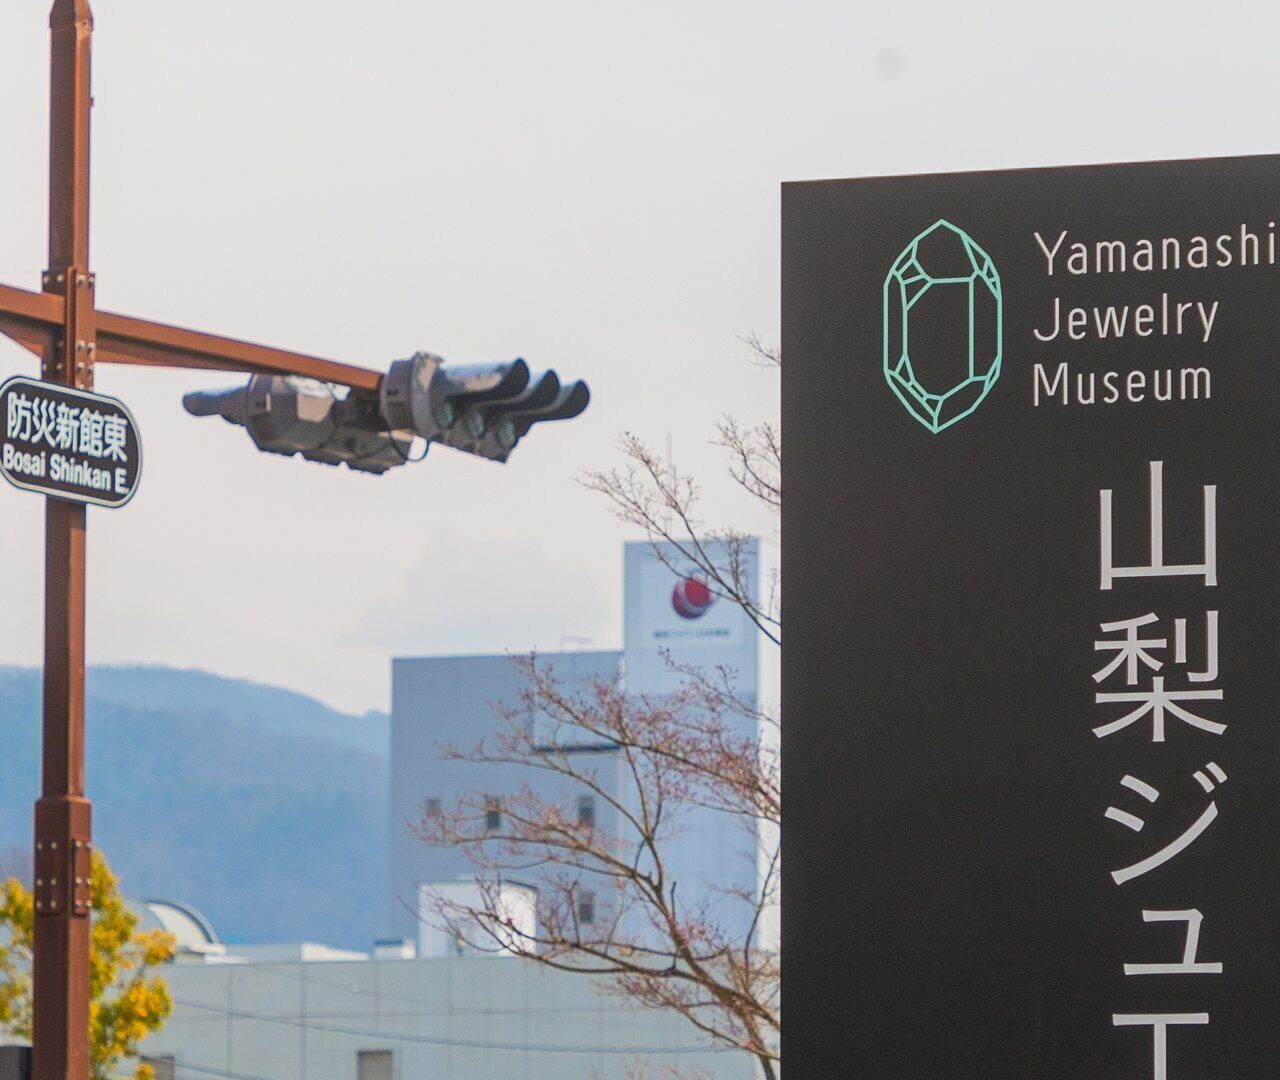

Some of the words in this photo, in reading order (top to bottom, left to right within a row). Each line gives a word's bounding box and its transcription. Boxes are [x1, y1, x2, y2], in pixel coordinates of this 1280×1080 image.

[1033, 221, 1277, 276] Yamanashi
[1033, 293, 1219, 343] Jewelry
[1033, 361, 1212, 407] Museum
[6, 391, 129, 463] 防災新館東
[3, 443, 47, 477] Bosai
[49, 453, 112, 492] Shinkan
